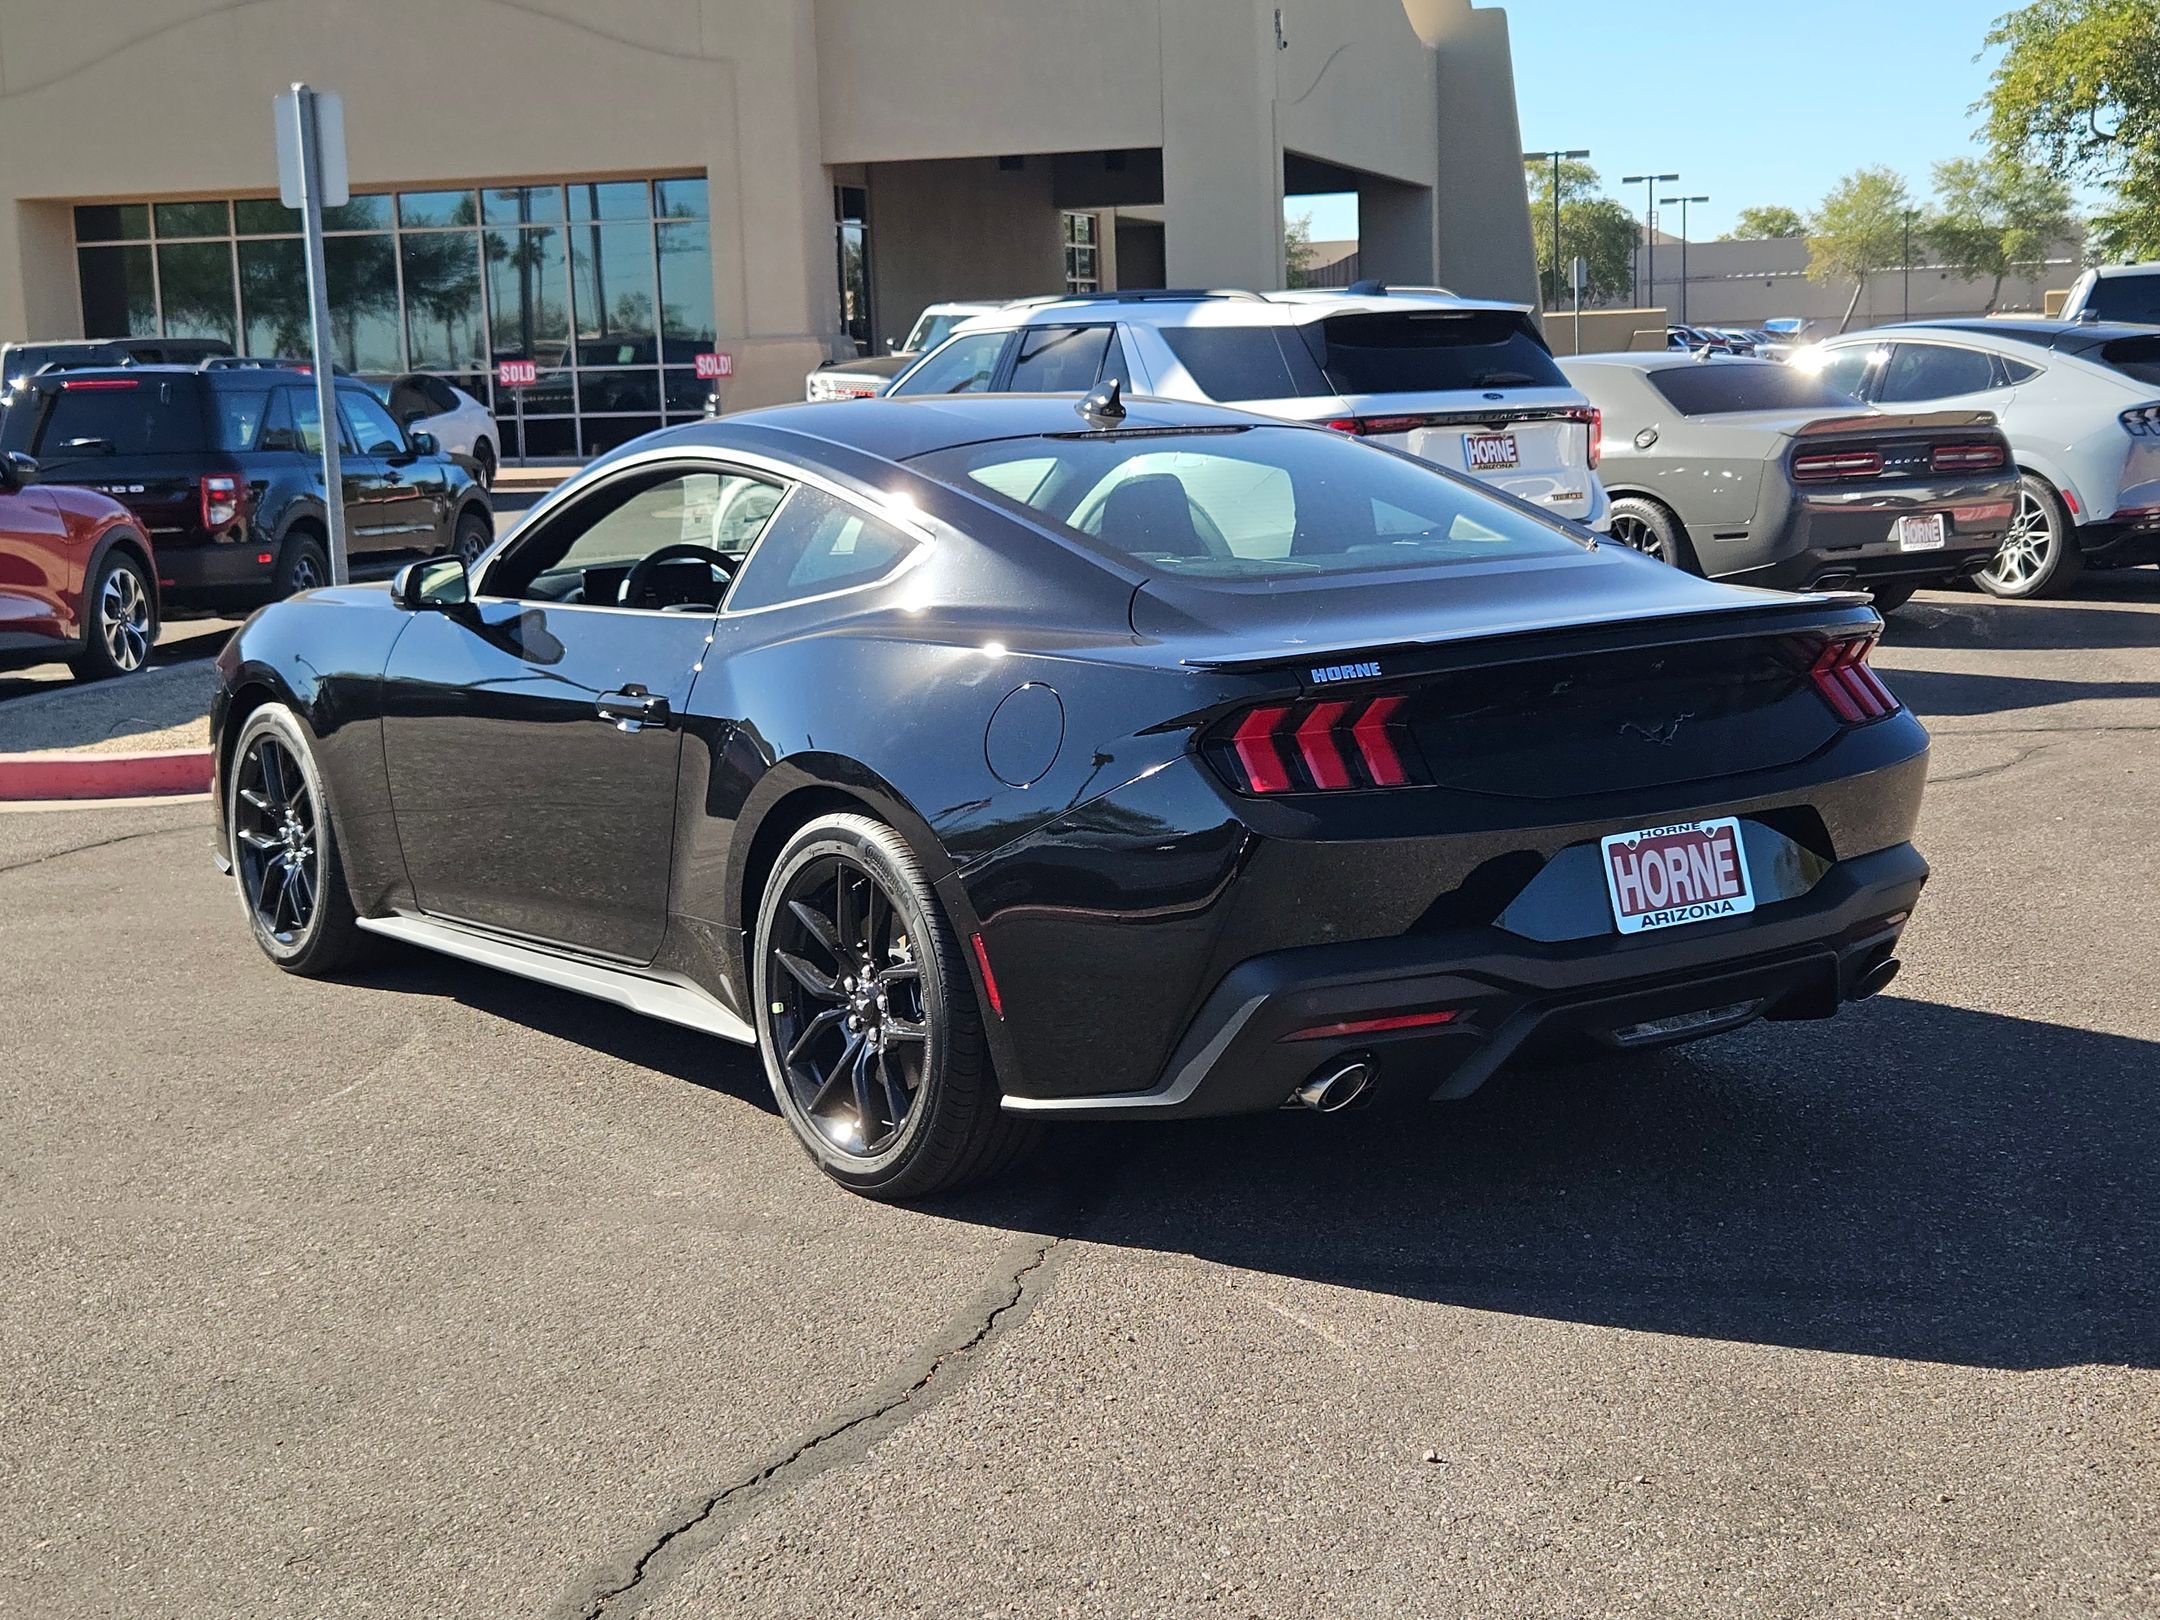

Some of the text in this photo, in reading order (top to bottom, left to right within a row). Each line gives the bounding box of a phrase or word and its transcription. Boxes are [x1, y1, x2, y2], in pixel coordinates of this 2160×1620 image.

[501, 365, 535, 382] SOLD
[698, 355, 732, 376] SOLD!
[1468, 439, 1517, 464] HORNE
[1902, 522, 1940, 544] HORNE
[1311, 661, 1382, 684] HORNE
[1639, 823, 1701, 839] HORNE
[1613, 838, 1739, 913] HORNE
[1641, 900, 1735, 929] ARIZONA
